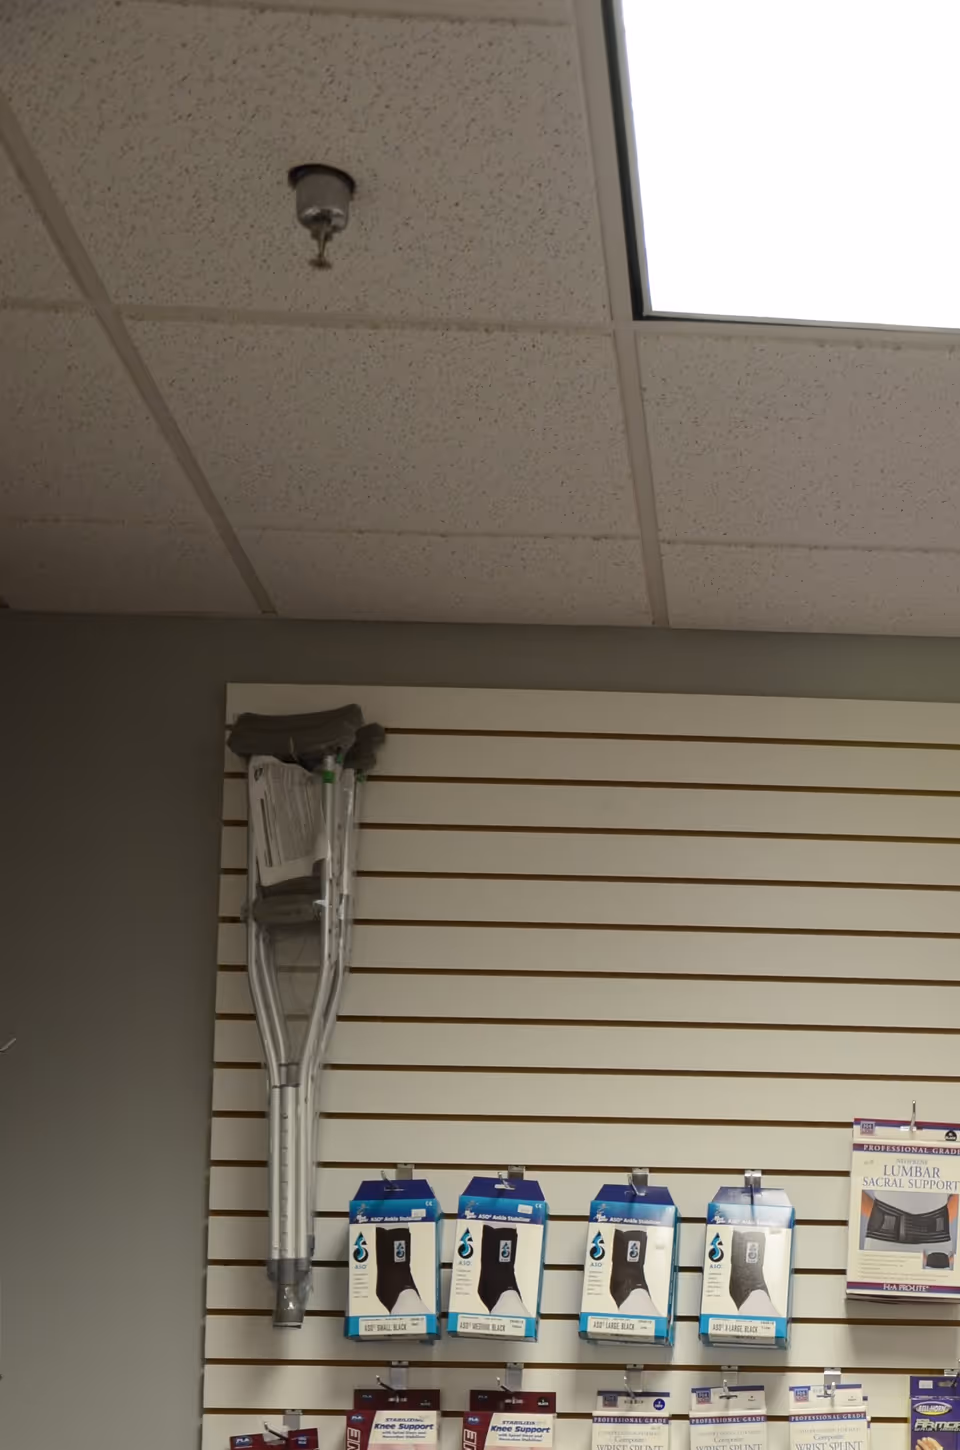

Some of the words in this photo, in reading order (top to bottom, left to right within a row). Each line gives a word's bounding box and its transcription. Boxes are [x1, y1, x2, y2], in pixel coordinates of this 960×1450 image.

[863, 1144, 929, 1153] PROFESSIONAL
[883, 1165, 940, 1178] LUMBAR
[862, 1177, 905, 1188] SACRAL
[908, 1179, 960, 1191] SUPPORT
[490, 1324, 505, 1332] BLACK
[744, 1325, 758, 1333] BLACK
[791, 1414, 840, 1422] PROFESSIONAL
[399, 1423, 434, 1431] Support
[490, 1425, 513, 1433] Knee
[514, 1425, 551, 1434] Support
